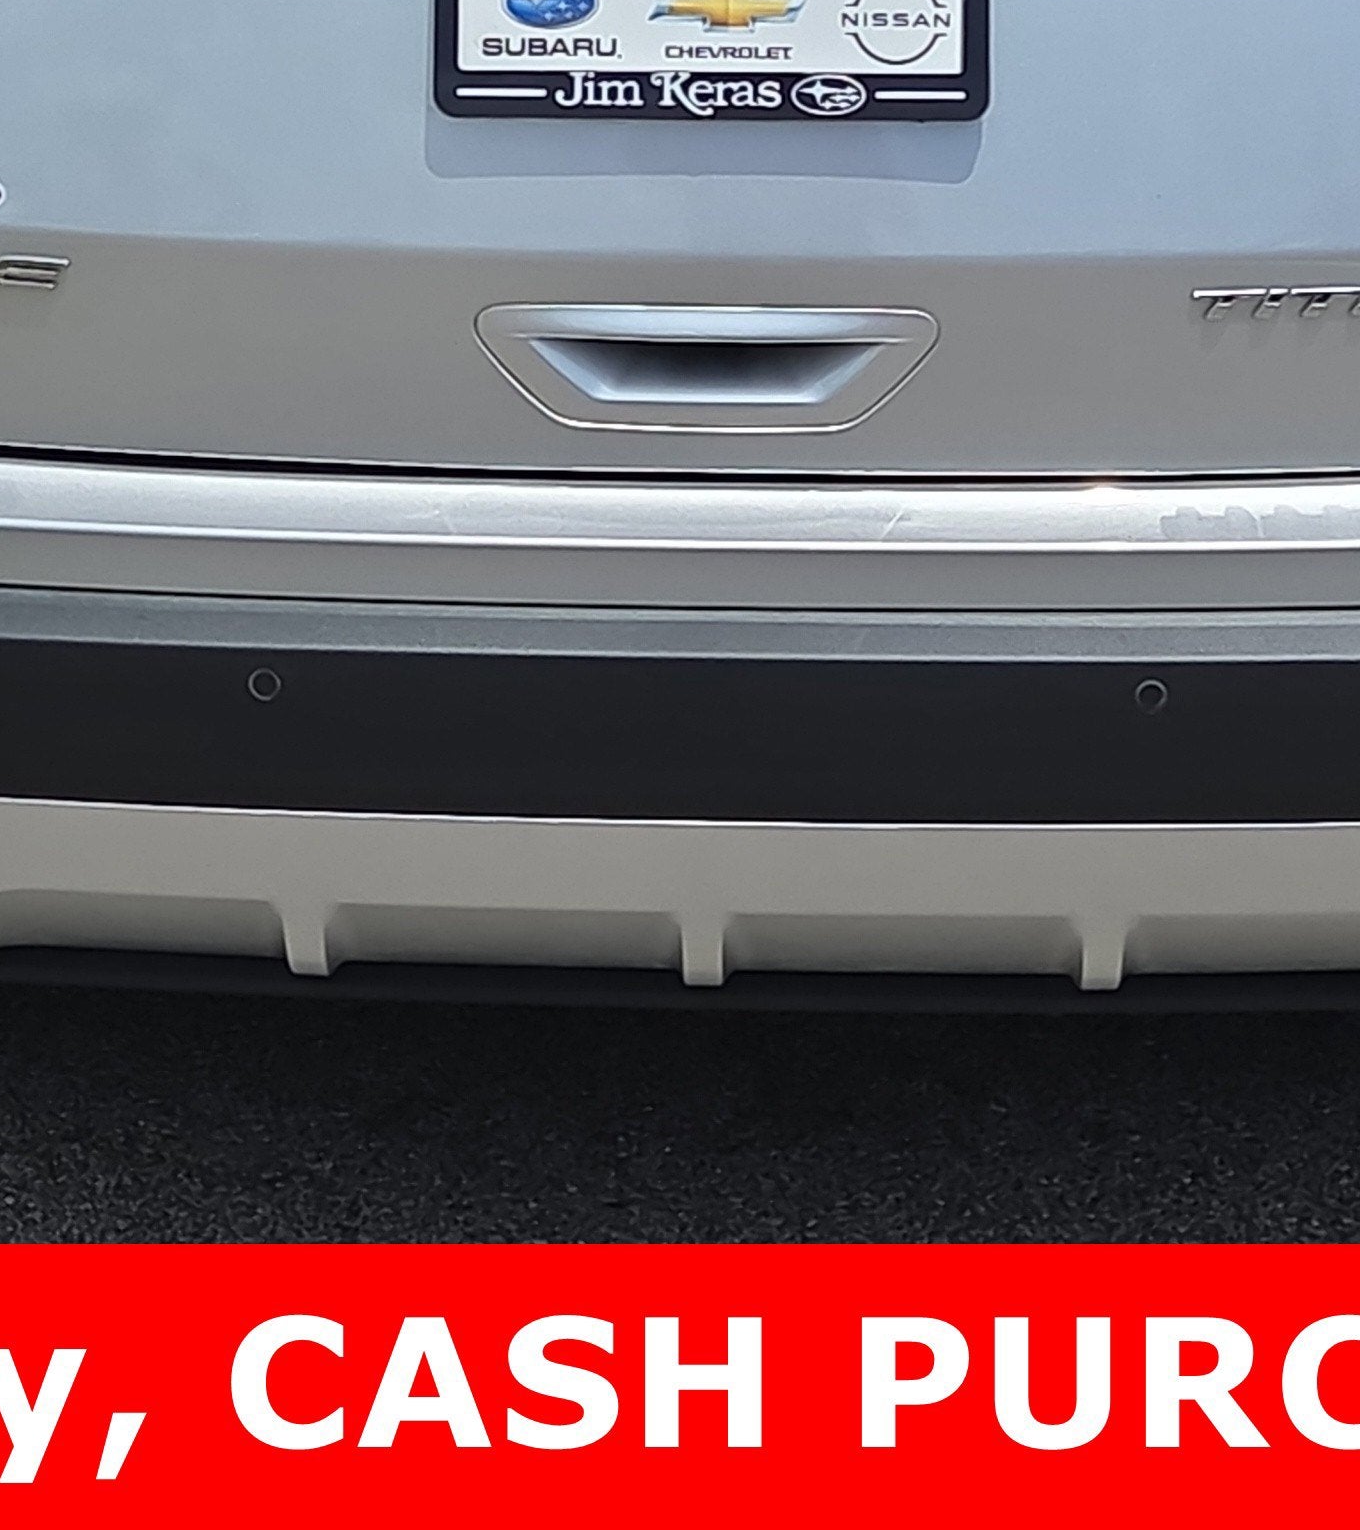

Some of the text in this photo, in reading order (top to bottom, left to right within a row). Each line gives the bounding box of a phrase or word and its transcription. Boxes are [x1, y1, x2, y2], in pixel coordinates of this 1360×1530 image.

[841, 12, 951, 28] NISSAN
[664, 46, 793, 59] CHEVROLET
[554, 71, 782, 116] Jim Keras
